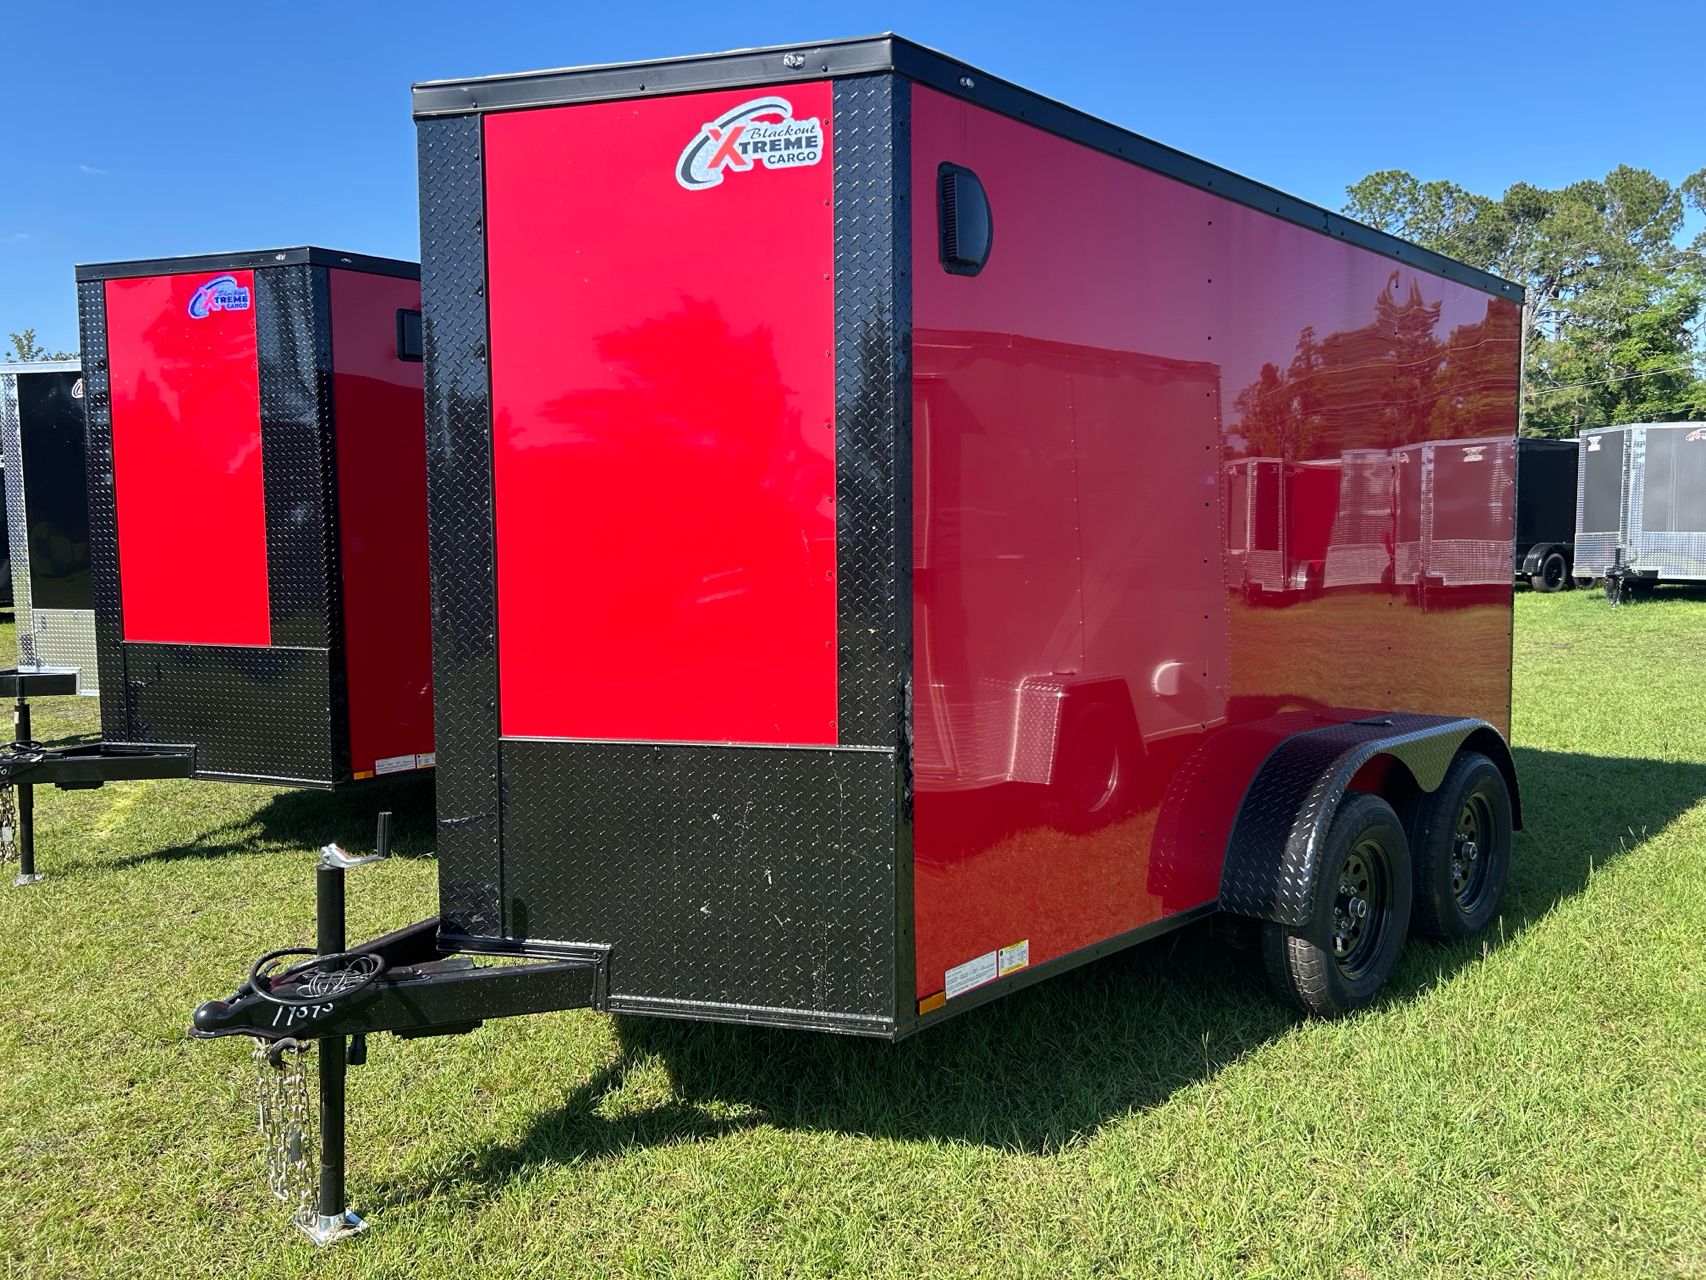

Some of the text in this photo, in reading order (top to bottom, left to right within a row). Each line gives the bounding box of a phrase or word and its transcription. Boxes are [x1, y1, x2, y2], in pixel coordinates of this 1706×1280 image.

[746, 124, 816, 140] Blackout
[706, 125, 818, 169] XTREME
[767, 151, 817, 165] CARGO
[201, 288, 249, 309] XTREME
